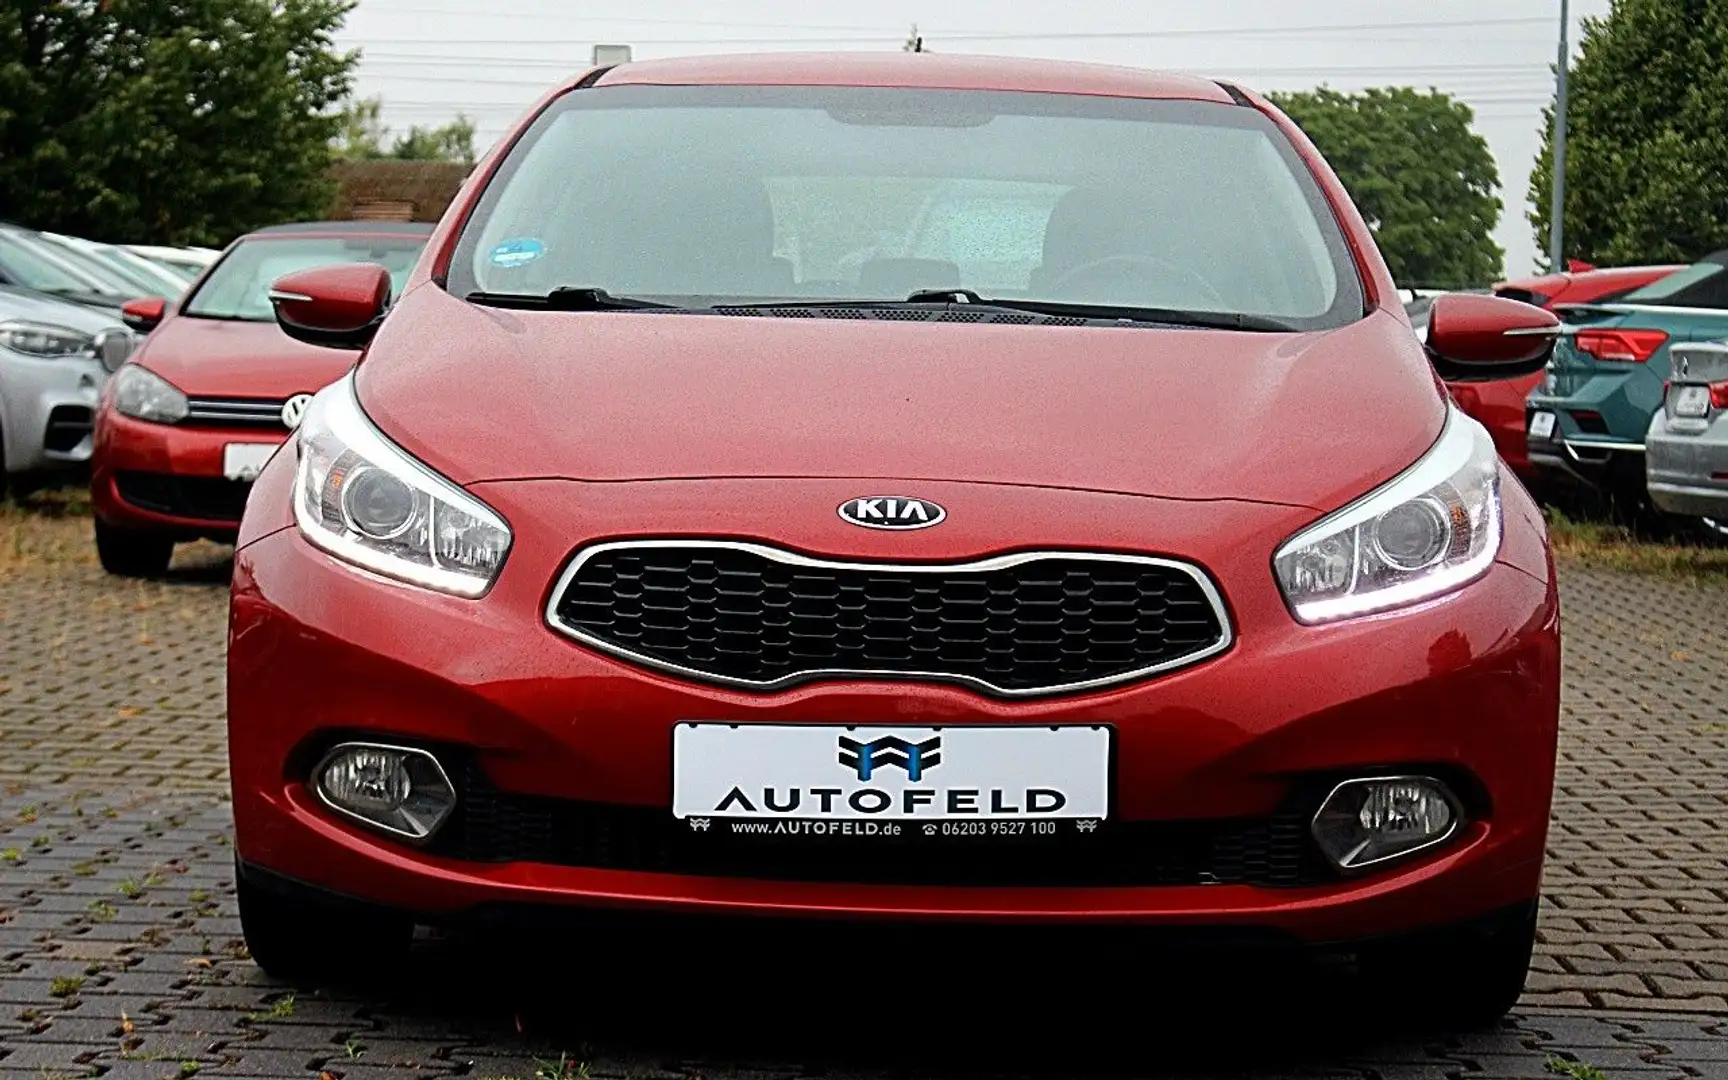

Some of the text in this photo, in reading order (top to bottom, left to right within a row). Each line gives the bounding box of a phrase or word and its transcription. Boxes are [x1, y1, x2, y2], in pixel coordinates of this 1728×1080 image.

[857, 499, 928, 520] KIA
[714, 786, 1066, 813] AUTOFELD
[731, 821, 1056, 835] www.AUTOFELD.de 06203 9527 100
